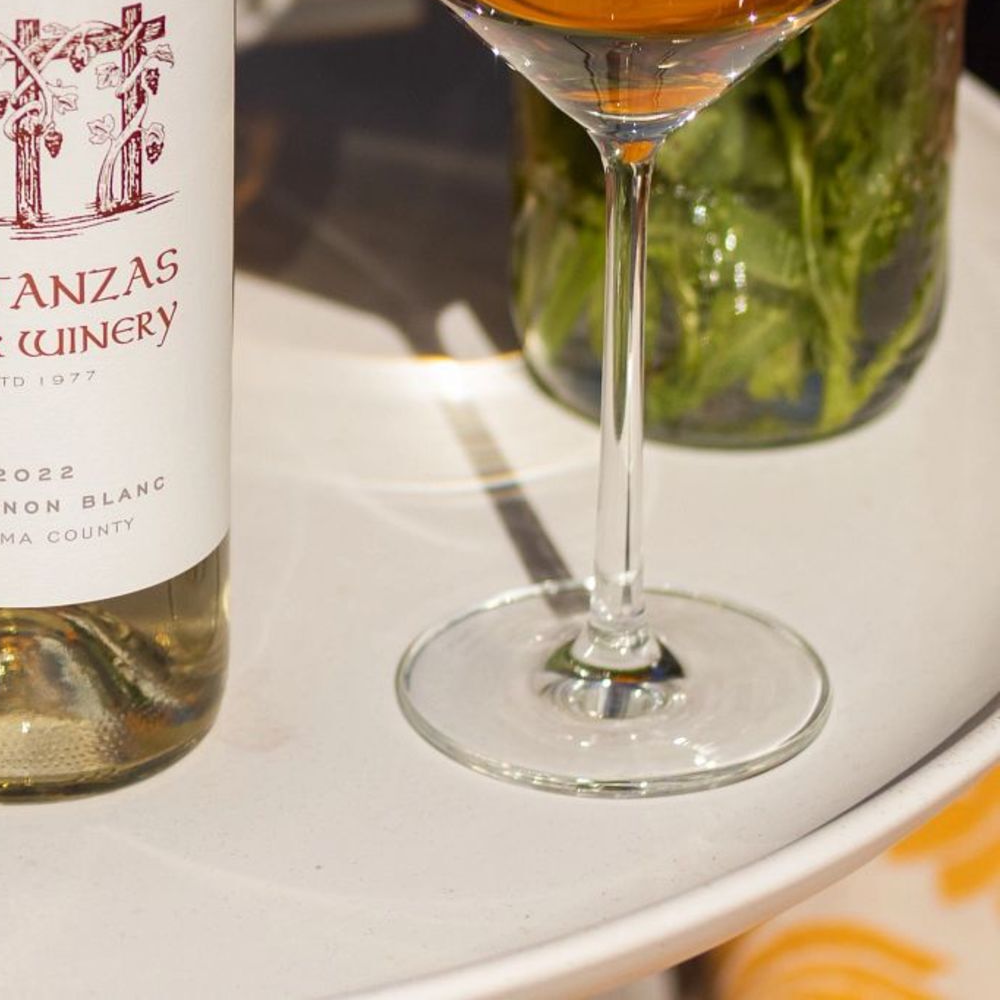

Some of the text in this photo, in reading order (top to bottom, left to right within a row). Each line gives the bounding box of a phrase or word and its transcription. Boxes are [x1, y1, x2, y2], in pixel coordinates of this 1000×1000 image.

[40, 370, 96, 386] 1977
[82, 476, 166, 510] BLANC
[47, 518, 134, 544] COUNTY
